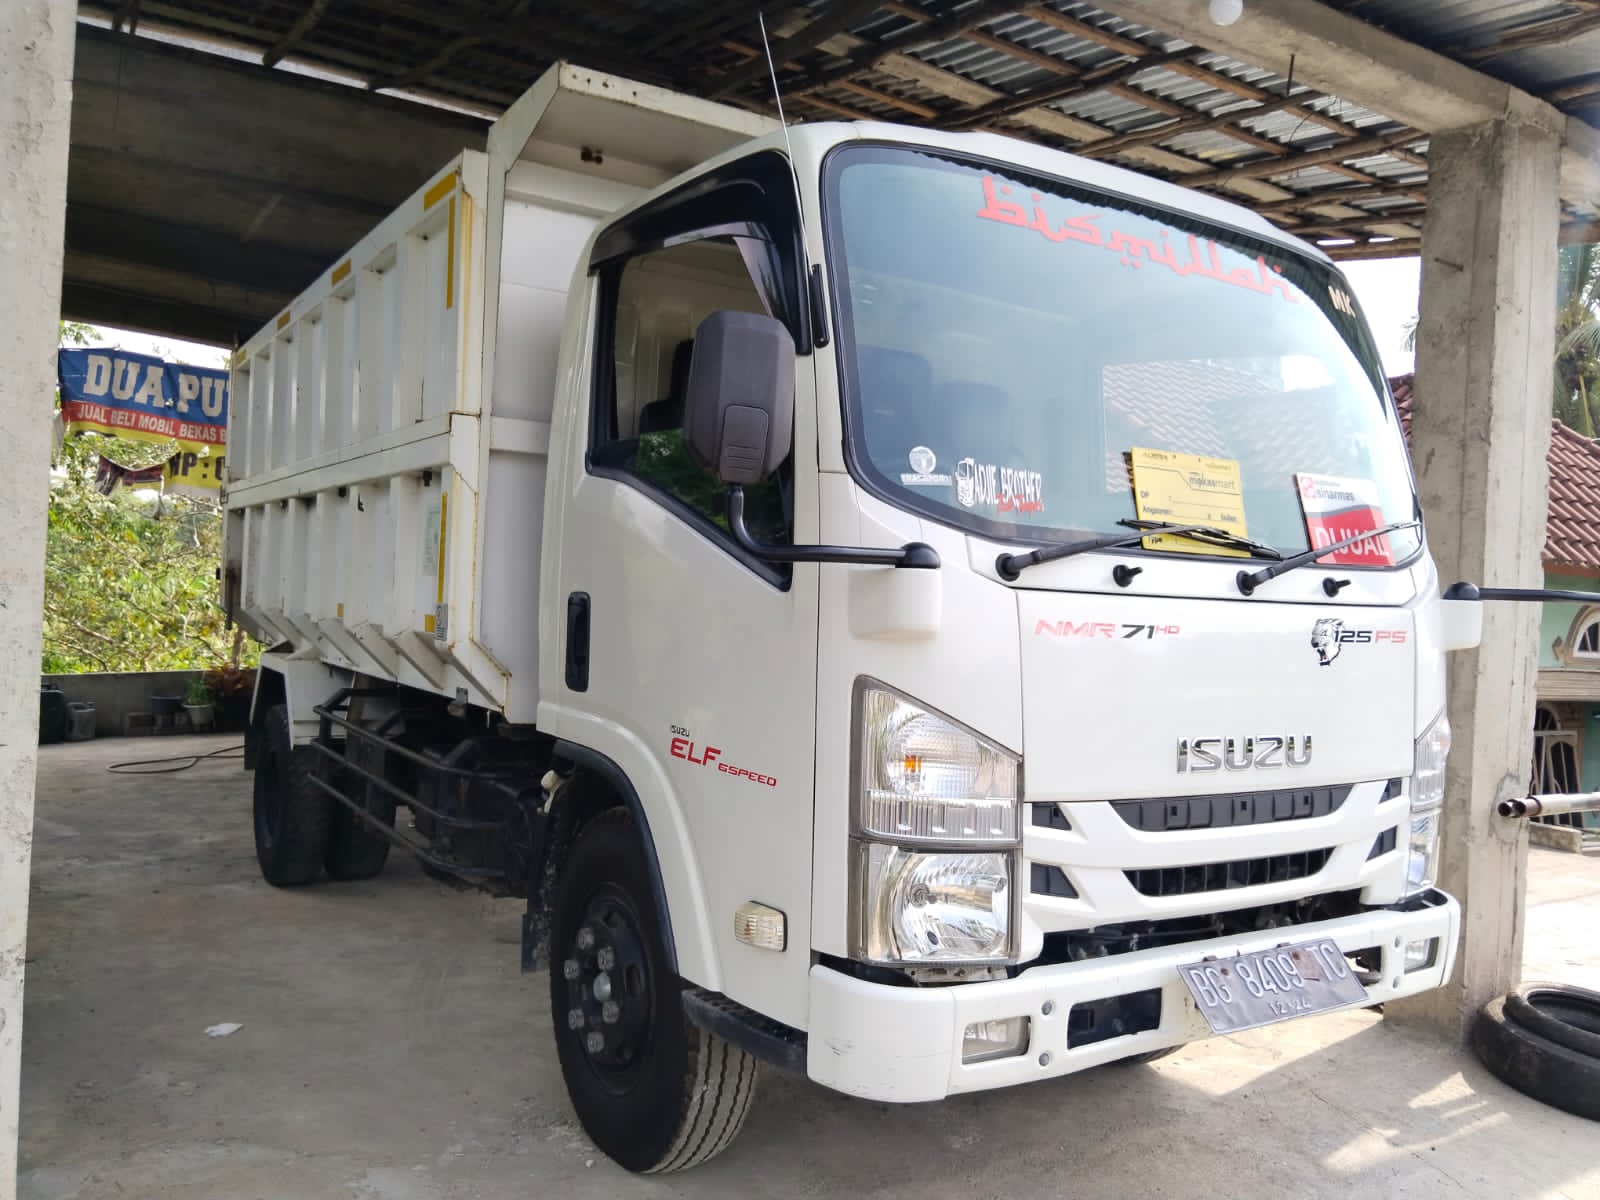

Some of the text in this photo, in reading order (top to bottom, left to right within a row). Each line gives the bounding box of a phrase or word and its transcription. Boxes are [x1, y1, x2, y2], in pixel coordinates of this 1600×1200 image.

[83, 354, 231, 417] DUA PU
[78, 404, 108, 424] JUAL
[111, 410, 136, 427] BELI
[179, 423, 217, 442] BEKAS
[1034, 619, 1116, 639] NMR
[670, 737, 721, 765] ELF
[1176, 733, 1312, 774] ISUZU
[1189, 943, 1347, 1007] BG 8409 TC
